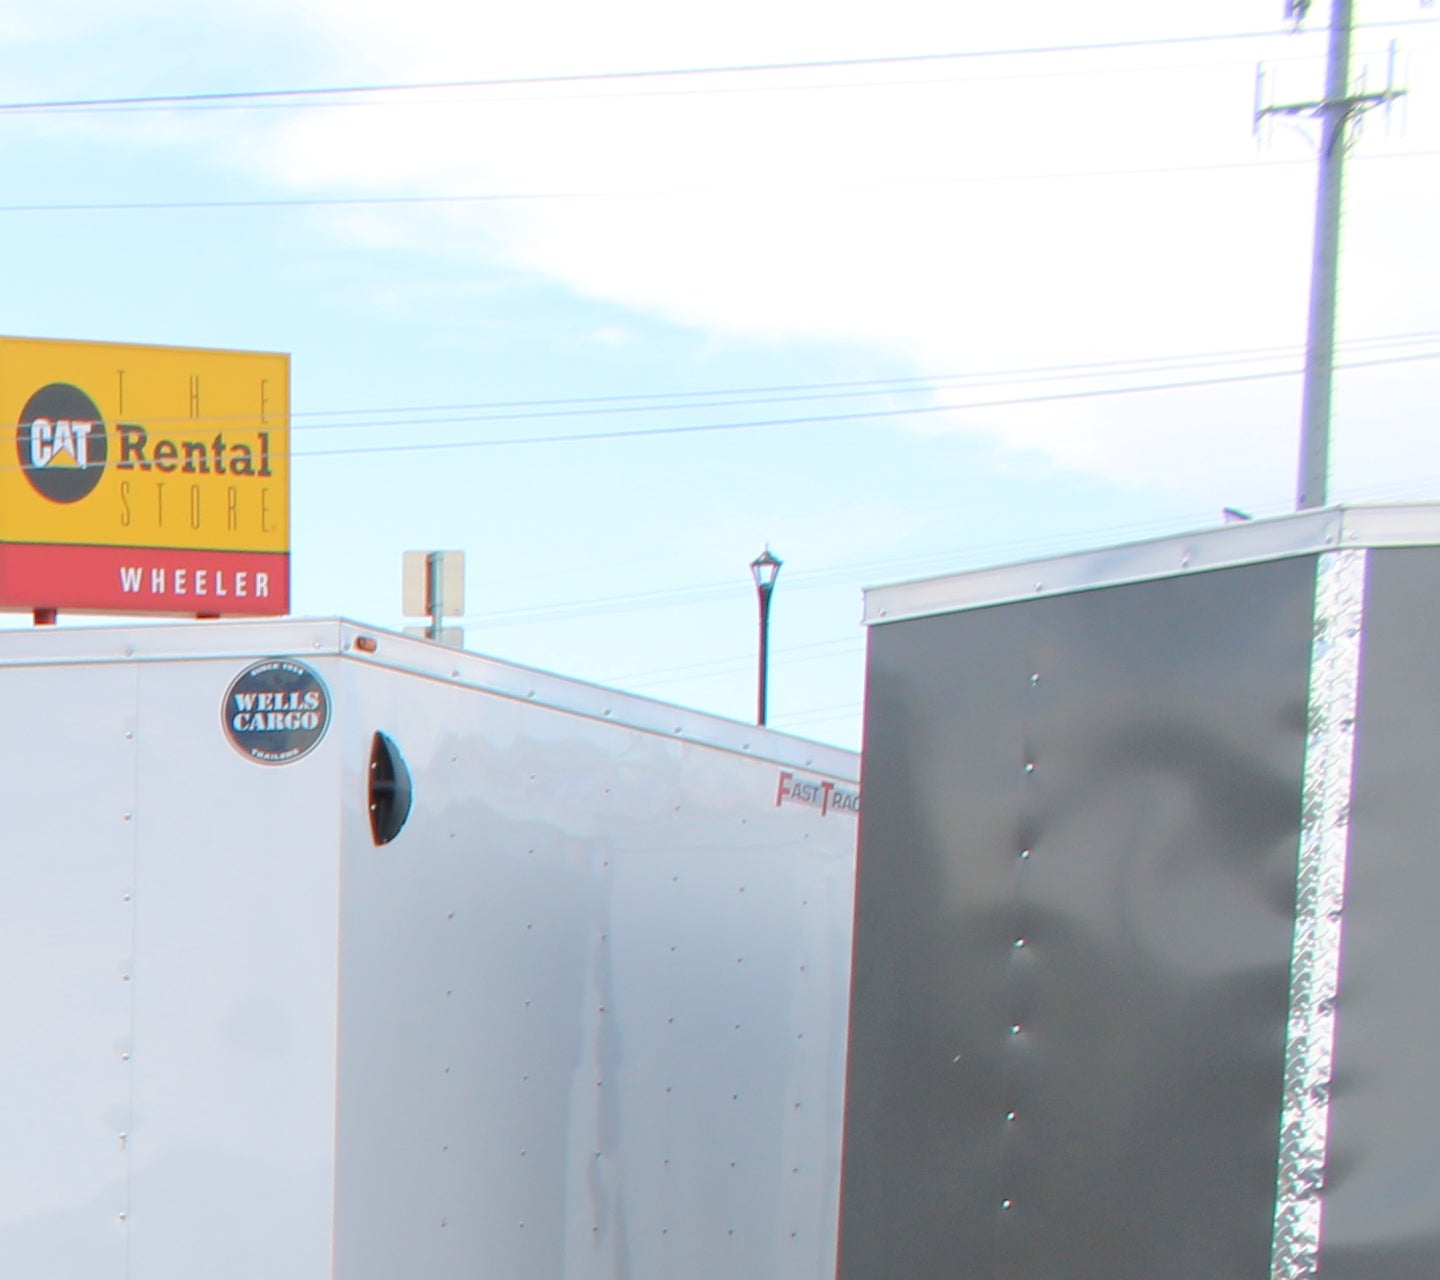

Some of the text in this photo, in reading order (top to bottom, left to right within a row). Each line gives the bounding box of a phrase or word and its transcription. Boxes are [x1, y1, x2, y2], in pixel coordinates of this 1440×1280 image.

[31, 418, 92, 469] CAT
[116, 424, 272, 477] Rental
[120, 481, 269, 532] STORE
[120, 566, 269, 598] WHEELER
[233, 690, 320, 711] WELLS
[233, 711, 321, 732] CARGO
